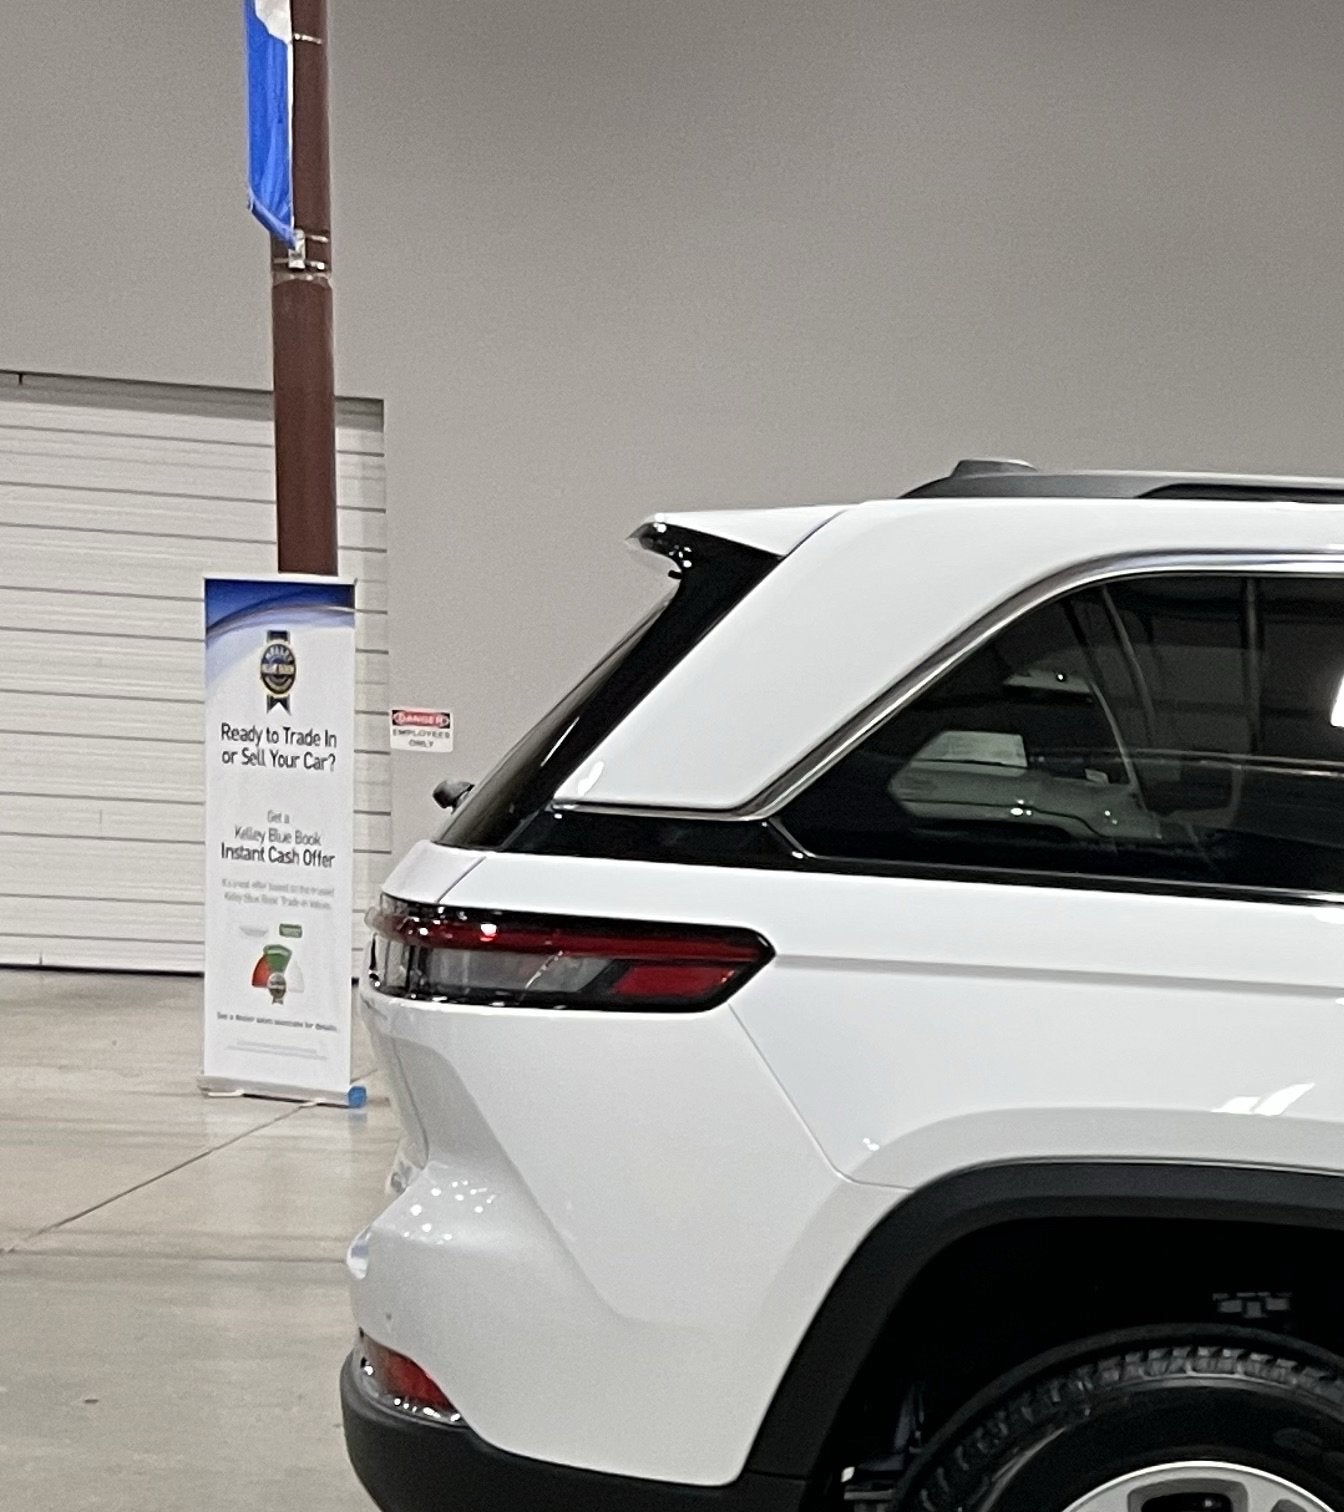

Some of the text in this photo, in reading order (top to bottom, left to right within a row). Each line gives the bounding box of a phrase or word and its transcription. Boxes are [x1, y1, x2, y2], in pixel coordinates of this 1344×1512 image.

[221, 722, 337, 748] Ready to Trade In
[221, 747, 336, 772] or Sell Your Car?
[268, 827, 292, 844] Blue
[294, 829, 321, 846] Book
[221, 841, 336, 868] Instant Cash Offer
